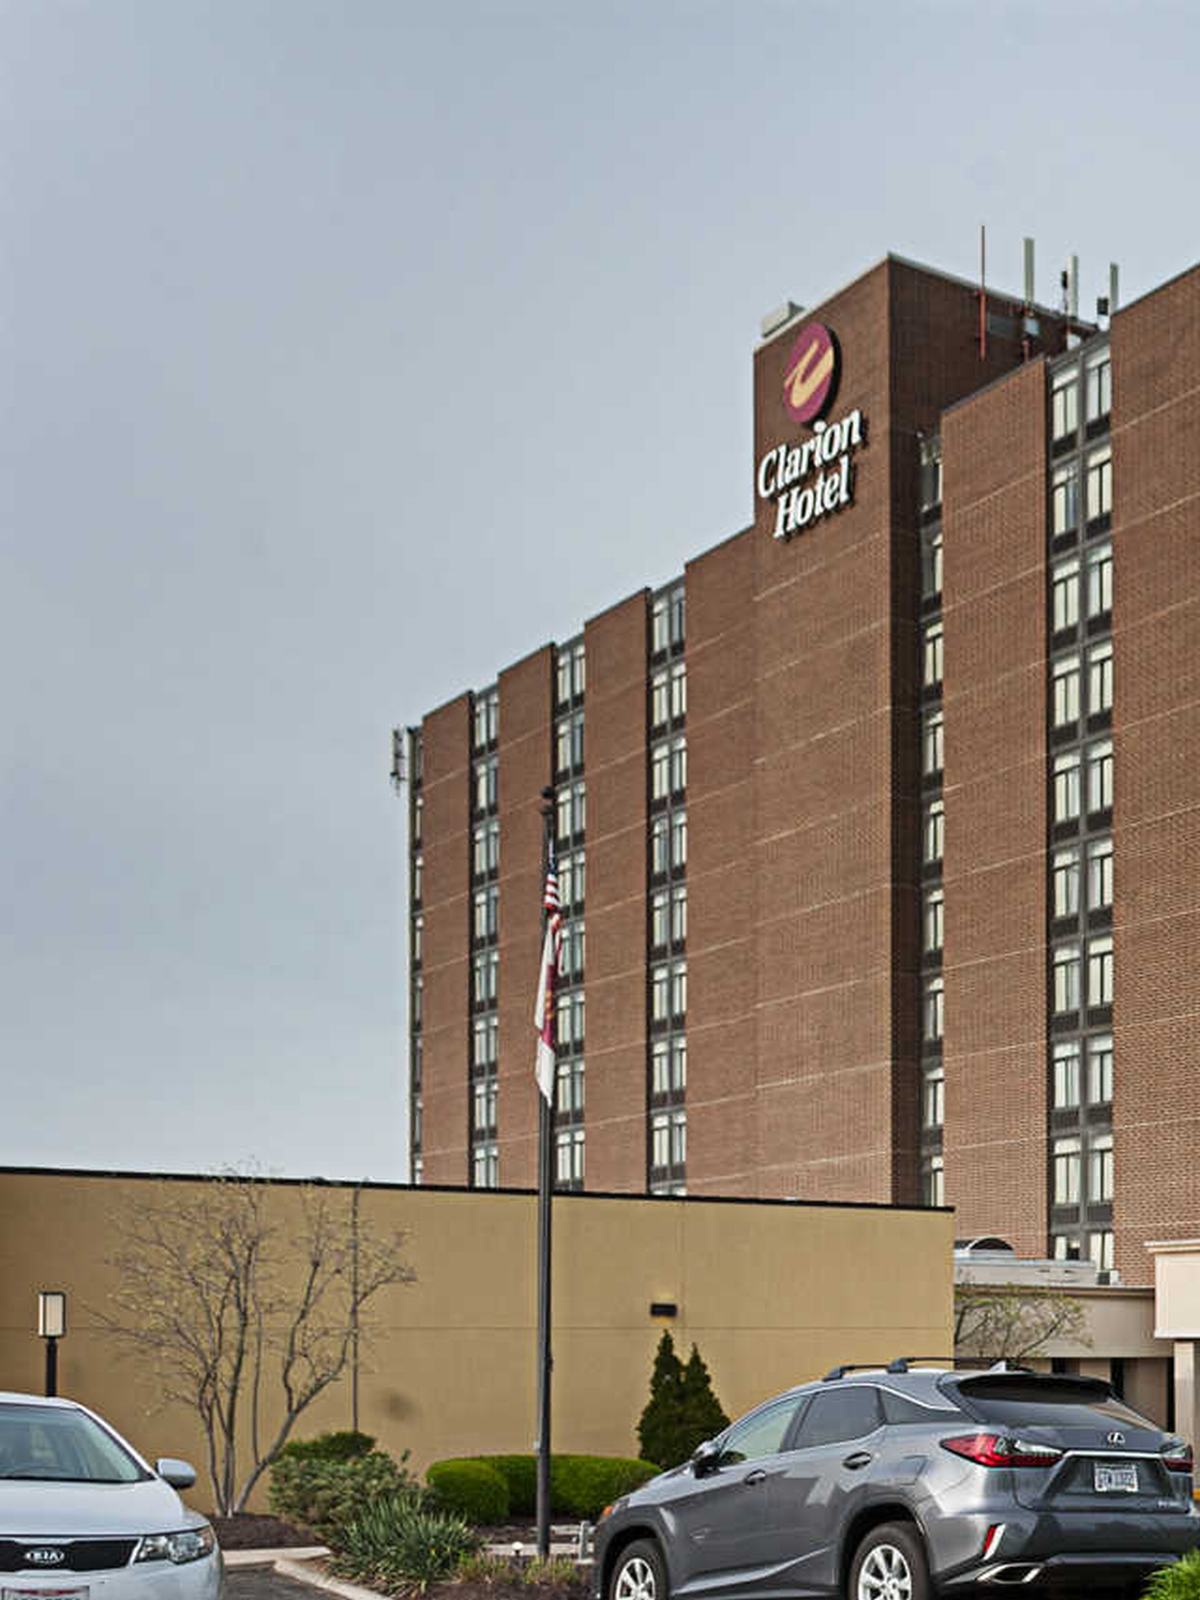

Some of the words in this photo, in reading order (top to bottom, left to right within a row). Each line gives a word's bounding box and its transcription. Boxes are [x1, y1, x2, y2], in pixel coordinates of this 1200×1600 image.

[758, 409, 862, 498] Clarion
[773, 454, 850, 538] Hotel
[34, 1550, 60, 1561] KIA
